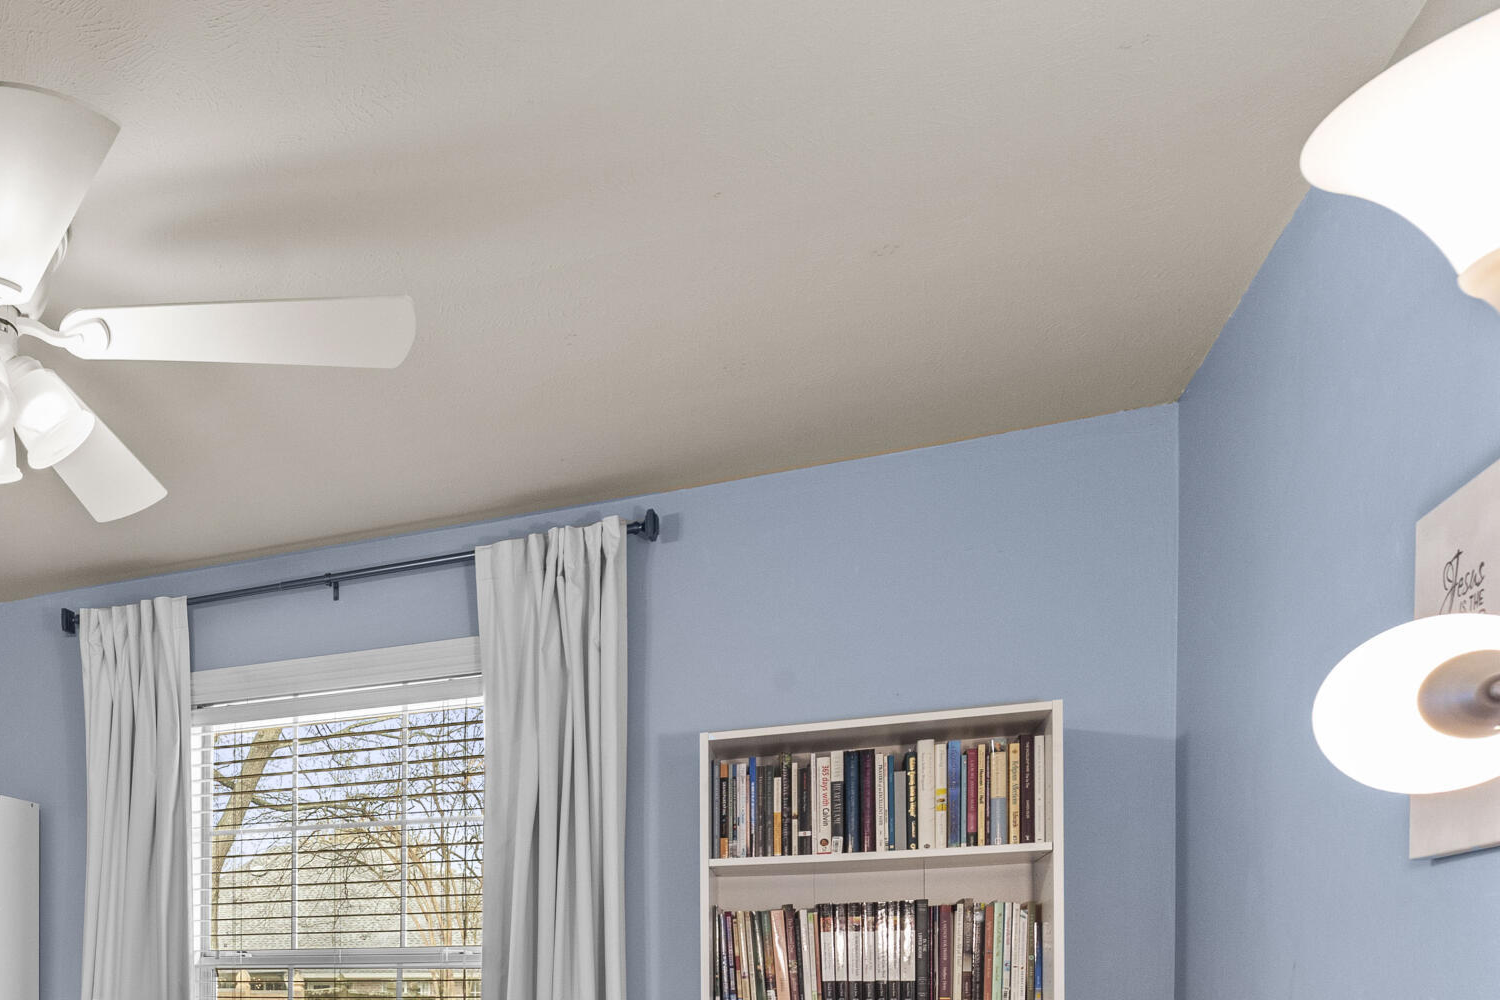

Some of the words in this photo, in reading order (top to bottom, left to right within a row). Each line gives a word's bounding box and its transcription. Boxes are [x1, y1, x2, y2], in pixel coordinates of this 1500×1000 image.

[1440, 549, 1485, 615] Jesus
[1469, 588, 1485, 612] THE
[821, 765, 829, 777] 365
[821, 777, 829, 792] days
[822, 807, 830, 827] Calvin
